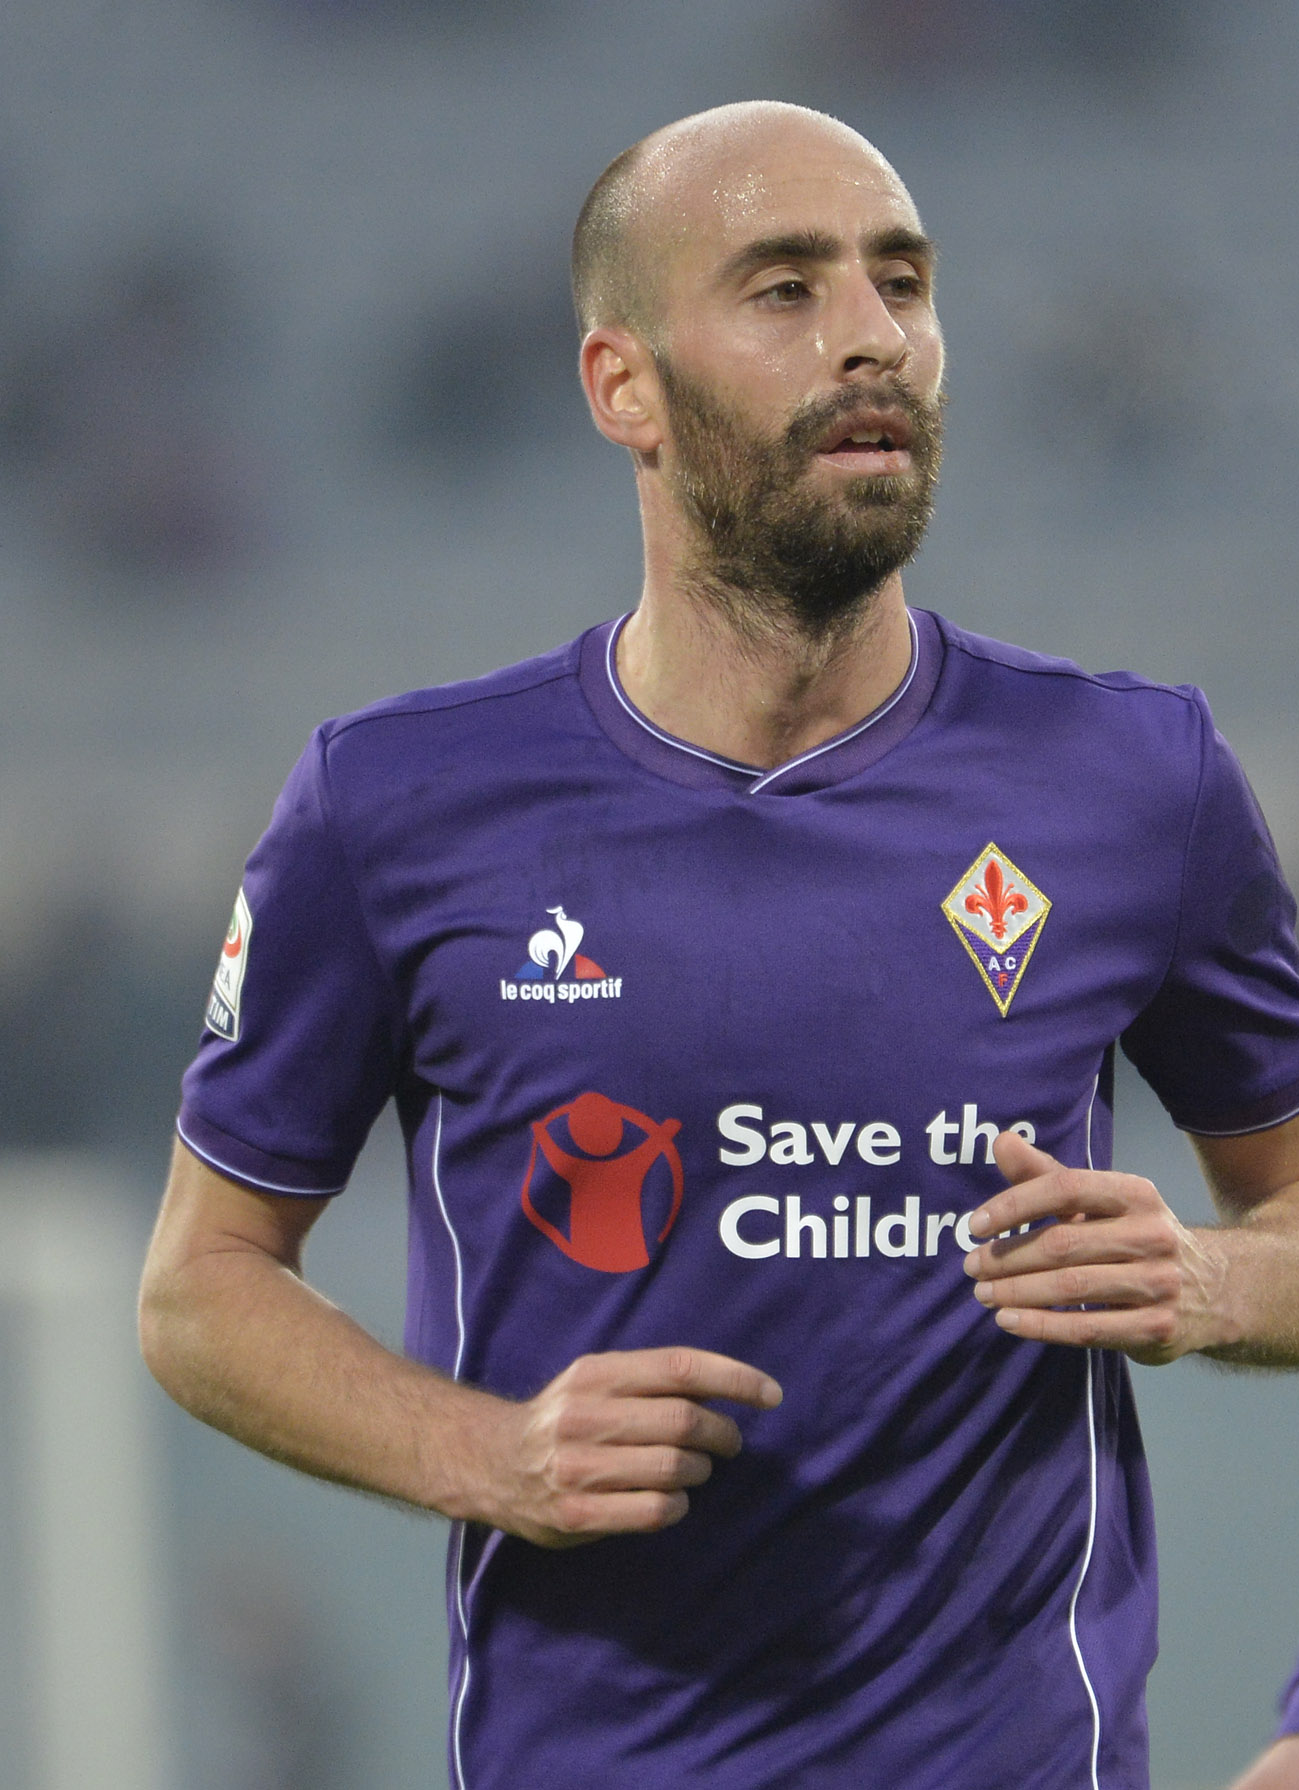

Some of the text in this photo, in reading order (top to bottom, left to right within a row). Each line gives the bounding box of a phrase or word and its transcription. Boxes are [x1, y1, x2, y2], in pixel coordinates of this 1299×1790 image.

[501, 978, 623, 1004] le coq sportif
[718, 1103, 901, 1166] Save
[719, 1195, 1030, 1259] Childr
